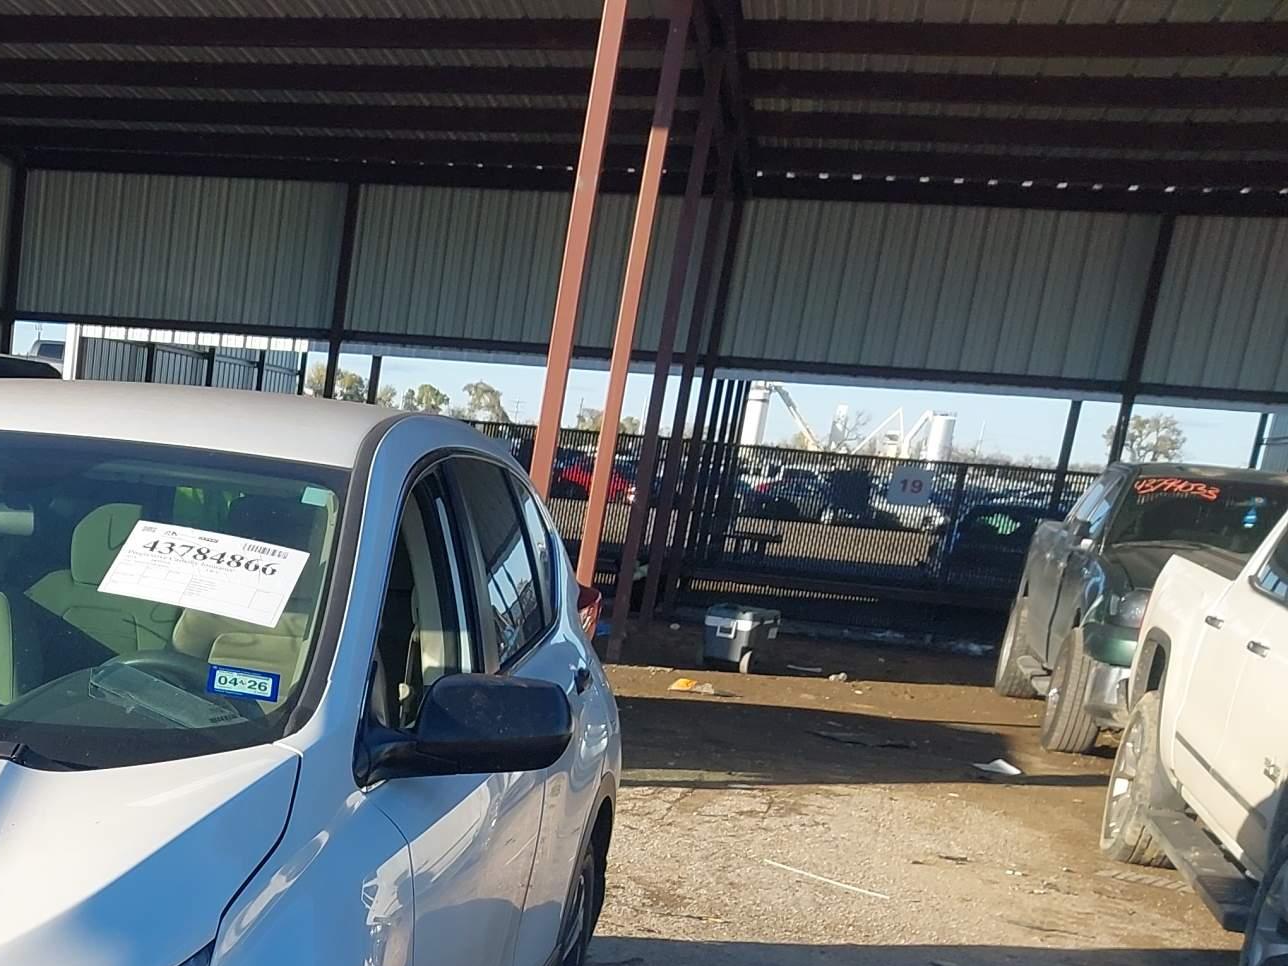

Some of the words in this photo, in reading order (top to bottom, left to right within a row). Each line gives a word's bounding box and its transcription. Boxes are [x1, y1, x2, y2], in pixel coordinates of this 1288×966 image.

[899, 478, 924, 494] 19
[142, 539, 280, 576] 43784866
[218, 675, 238, 687] 04
[247, 679, 268, 692] 26
